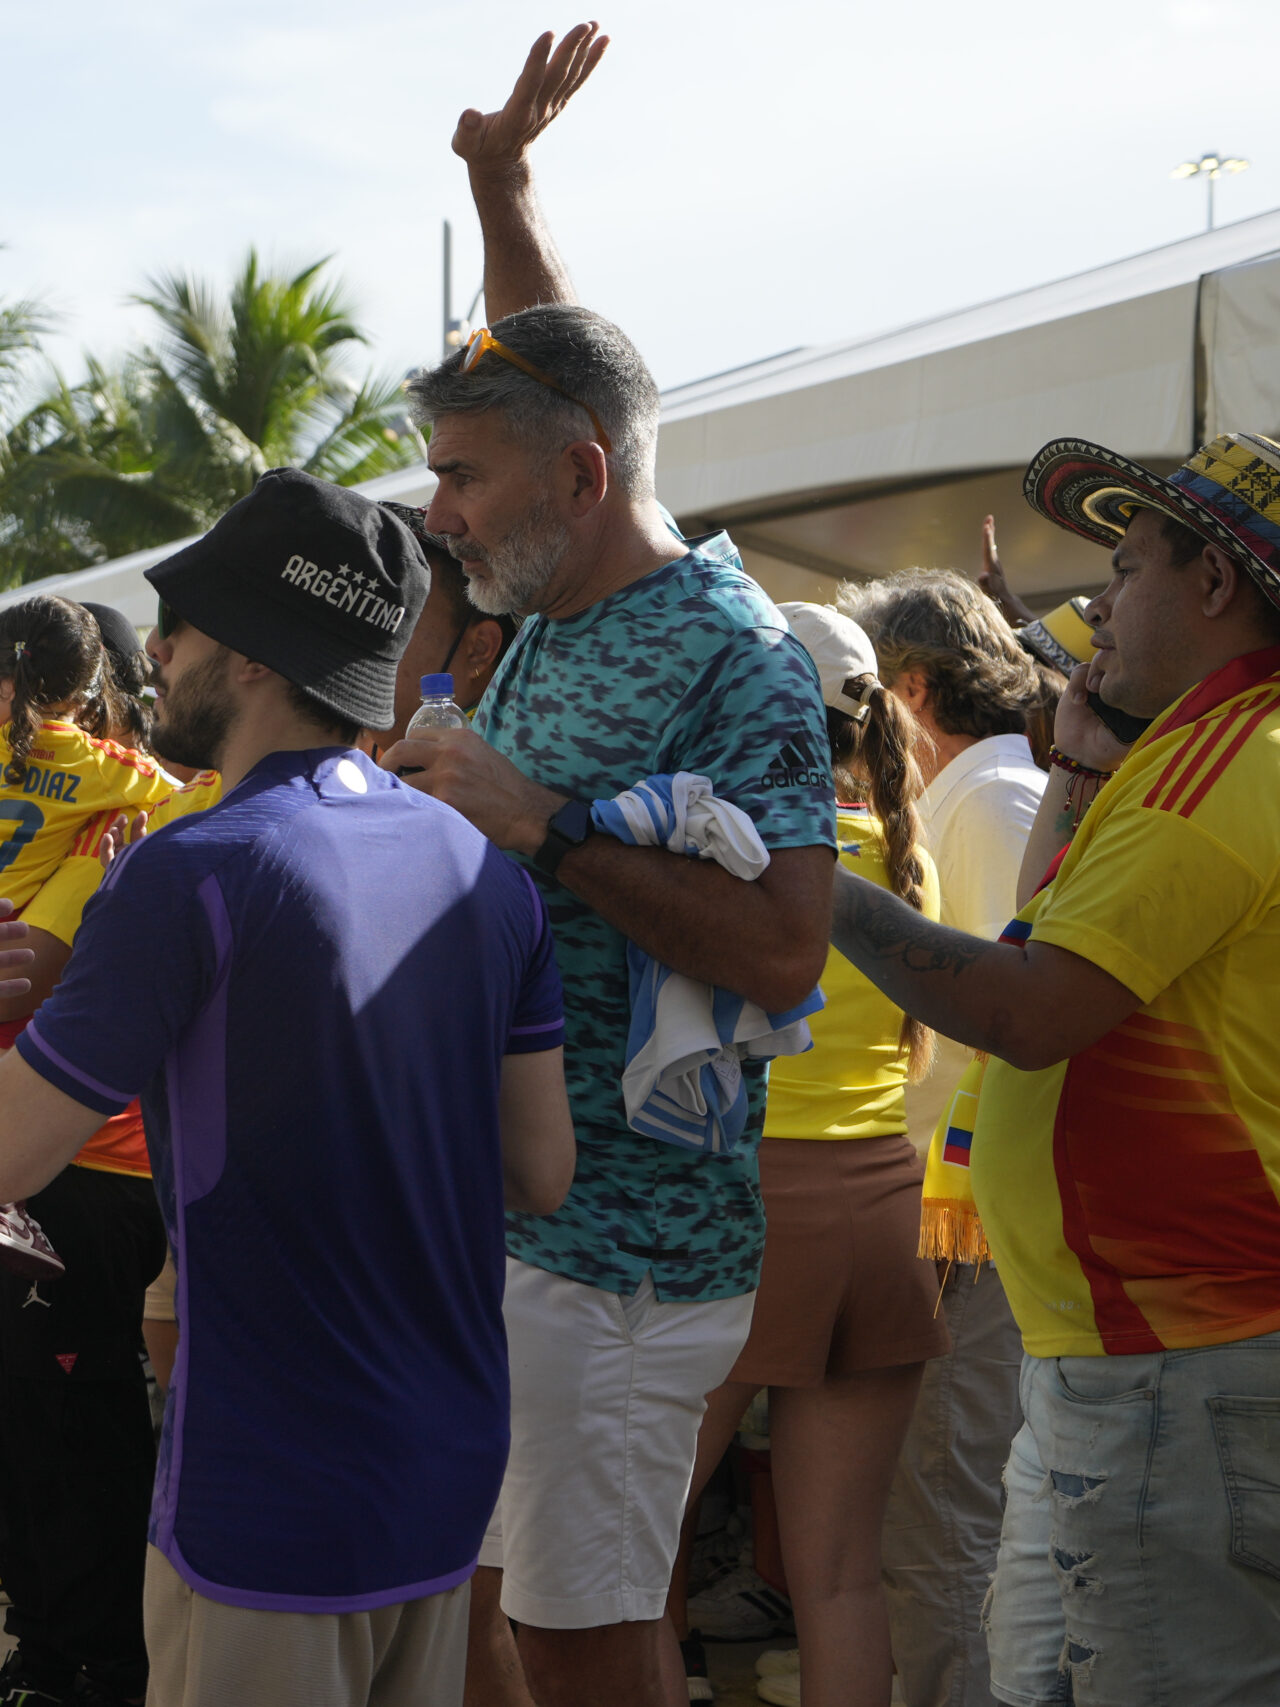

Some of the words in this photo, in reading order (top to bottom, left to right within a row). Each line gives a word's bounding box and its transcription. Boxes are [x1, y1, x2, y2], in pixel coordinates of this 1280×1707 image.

[281, 554, 405, 633] ARGENTINA
[23, 766, 81, 803] DIAZ
[761, 767, 828, 789] adidas
